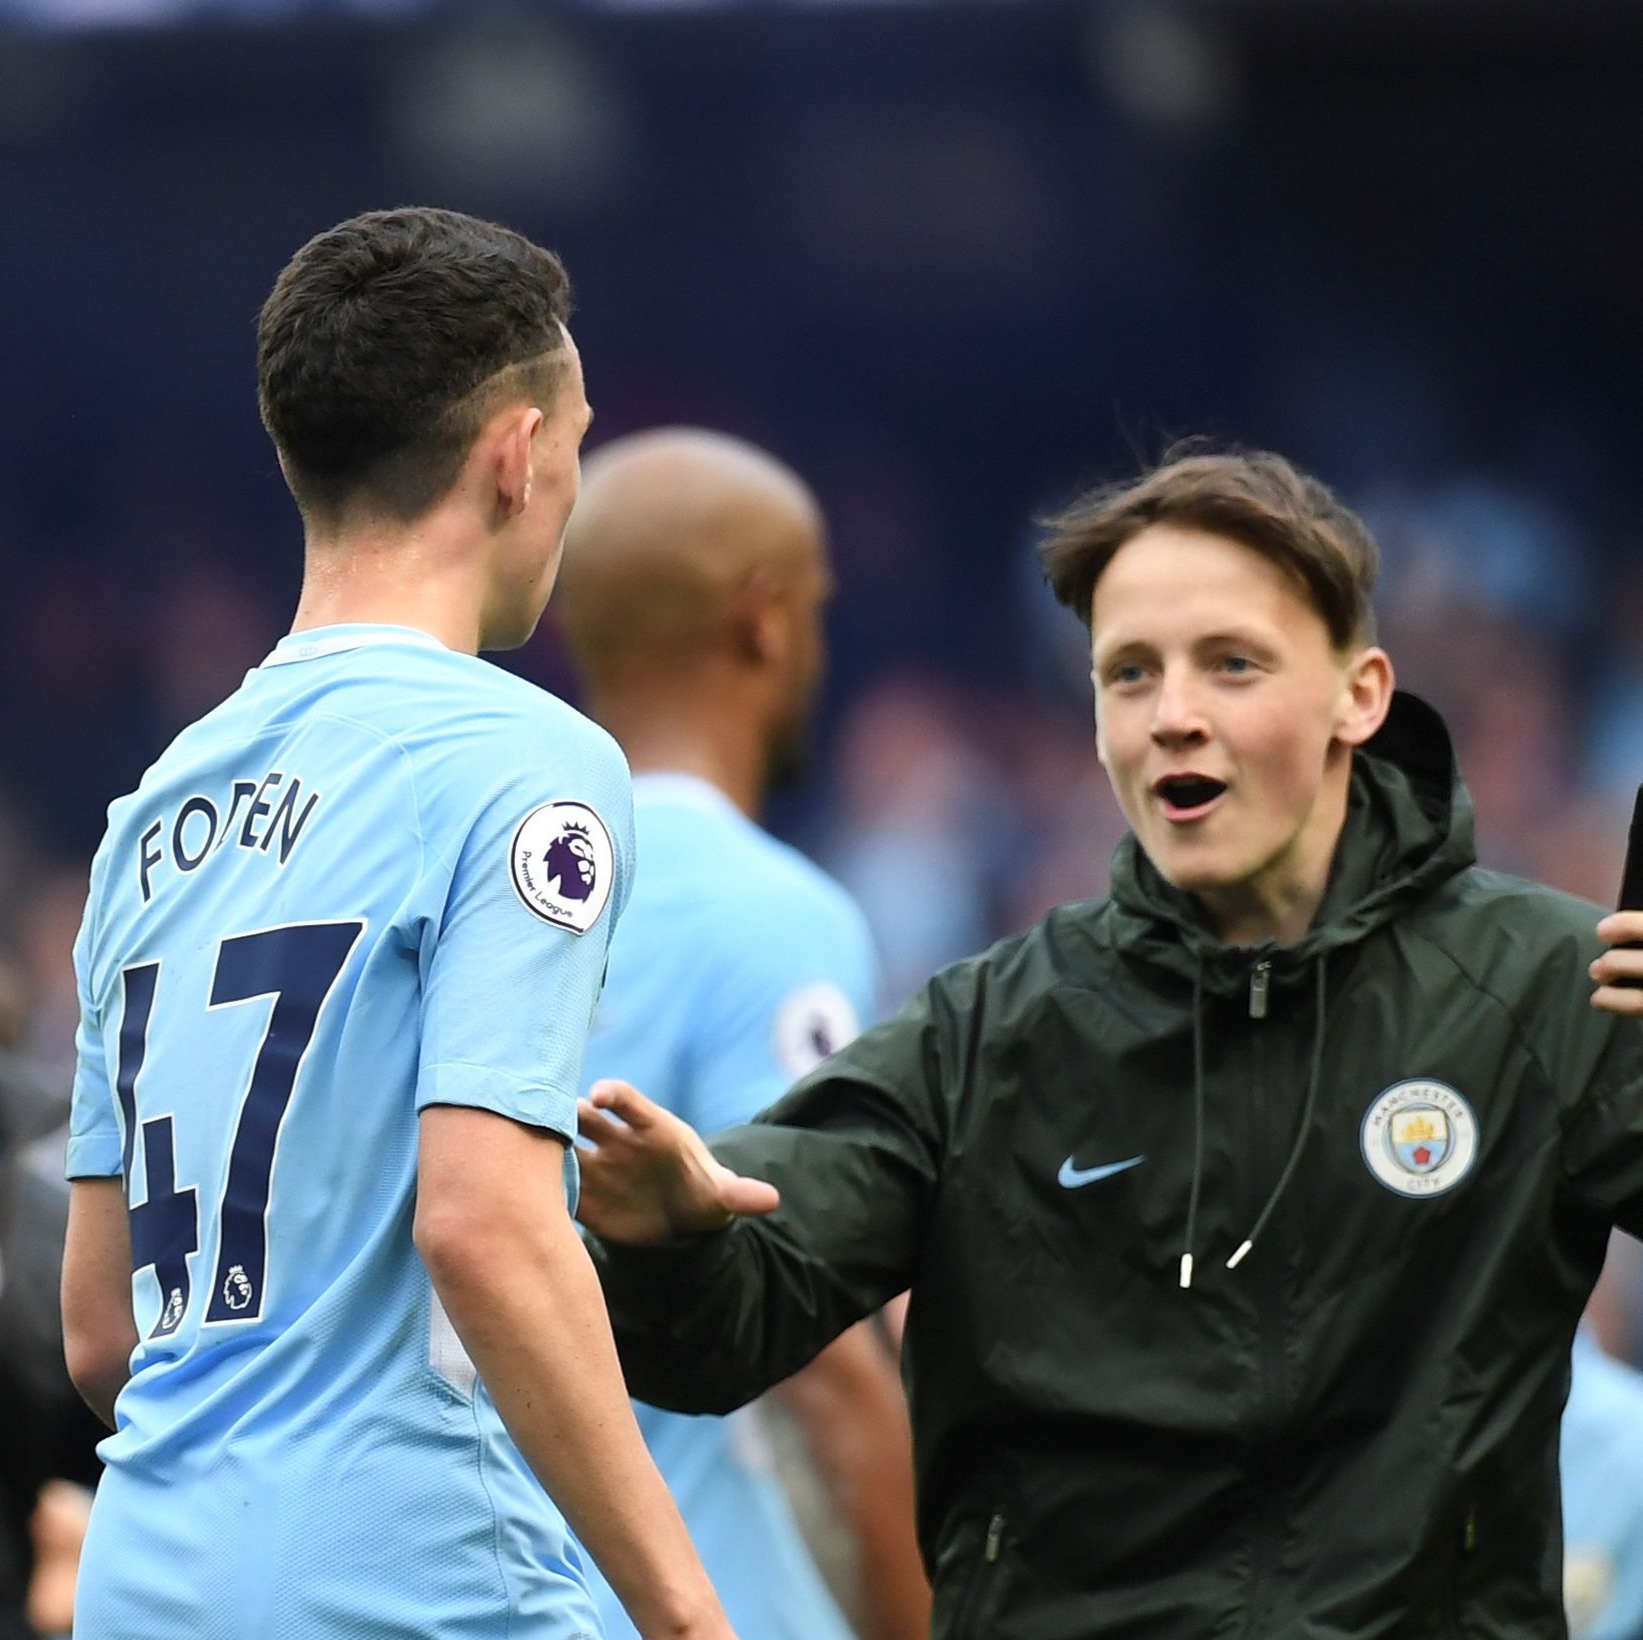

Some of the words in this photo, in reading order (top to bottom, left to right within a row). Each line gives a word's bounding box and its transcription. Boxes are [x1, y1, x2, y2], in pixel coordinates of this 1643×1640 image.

[521, 850, 537, 892] Premier
[534, 891, 573, 918] League
[115, 917, 368, 1342] 47
